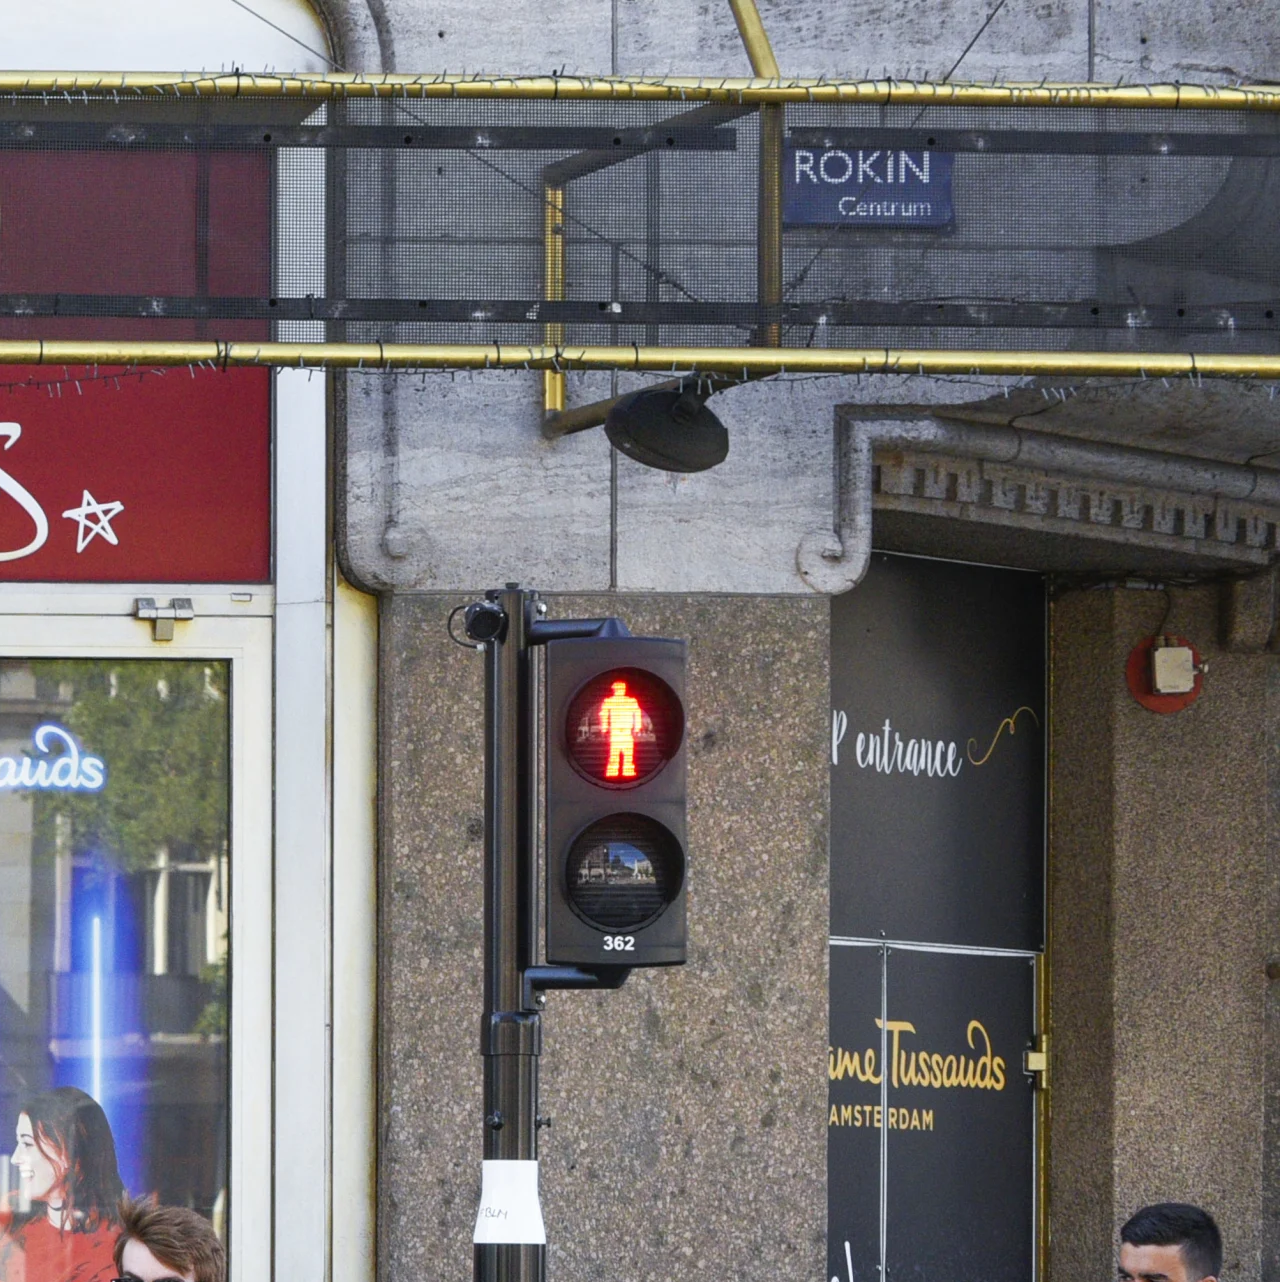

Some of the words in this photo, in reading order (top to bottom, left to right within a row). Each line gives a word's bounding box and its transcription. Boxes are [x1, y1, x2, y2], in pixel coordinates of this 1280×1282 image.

[794, 148, 931, 184] ROKIN
[838, 195, 932, 217] Centrum
[830, 709, 847, 766] P
[856, 717, 962, 777] entrance
[603, 936, 635, 952] 362
[875, 1018, 1006, 1091] Tussauds
[829, 1103, 934, 1132] AMSTERDAM
